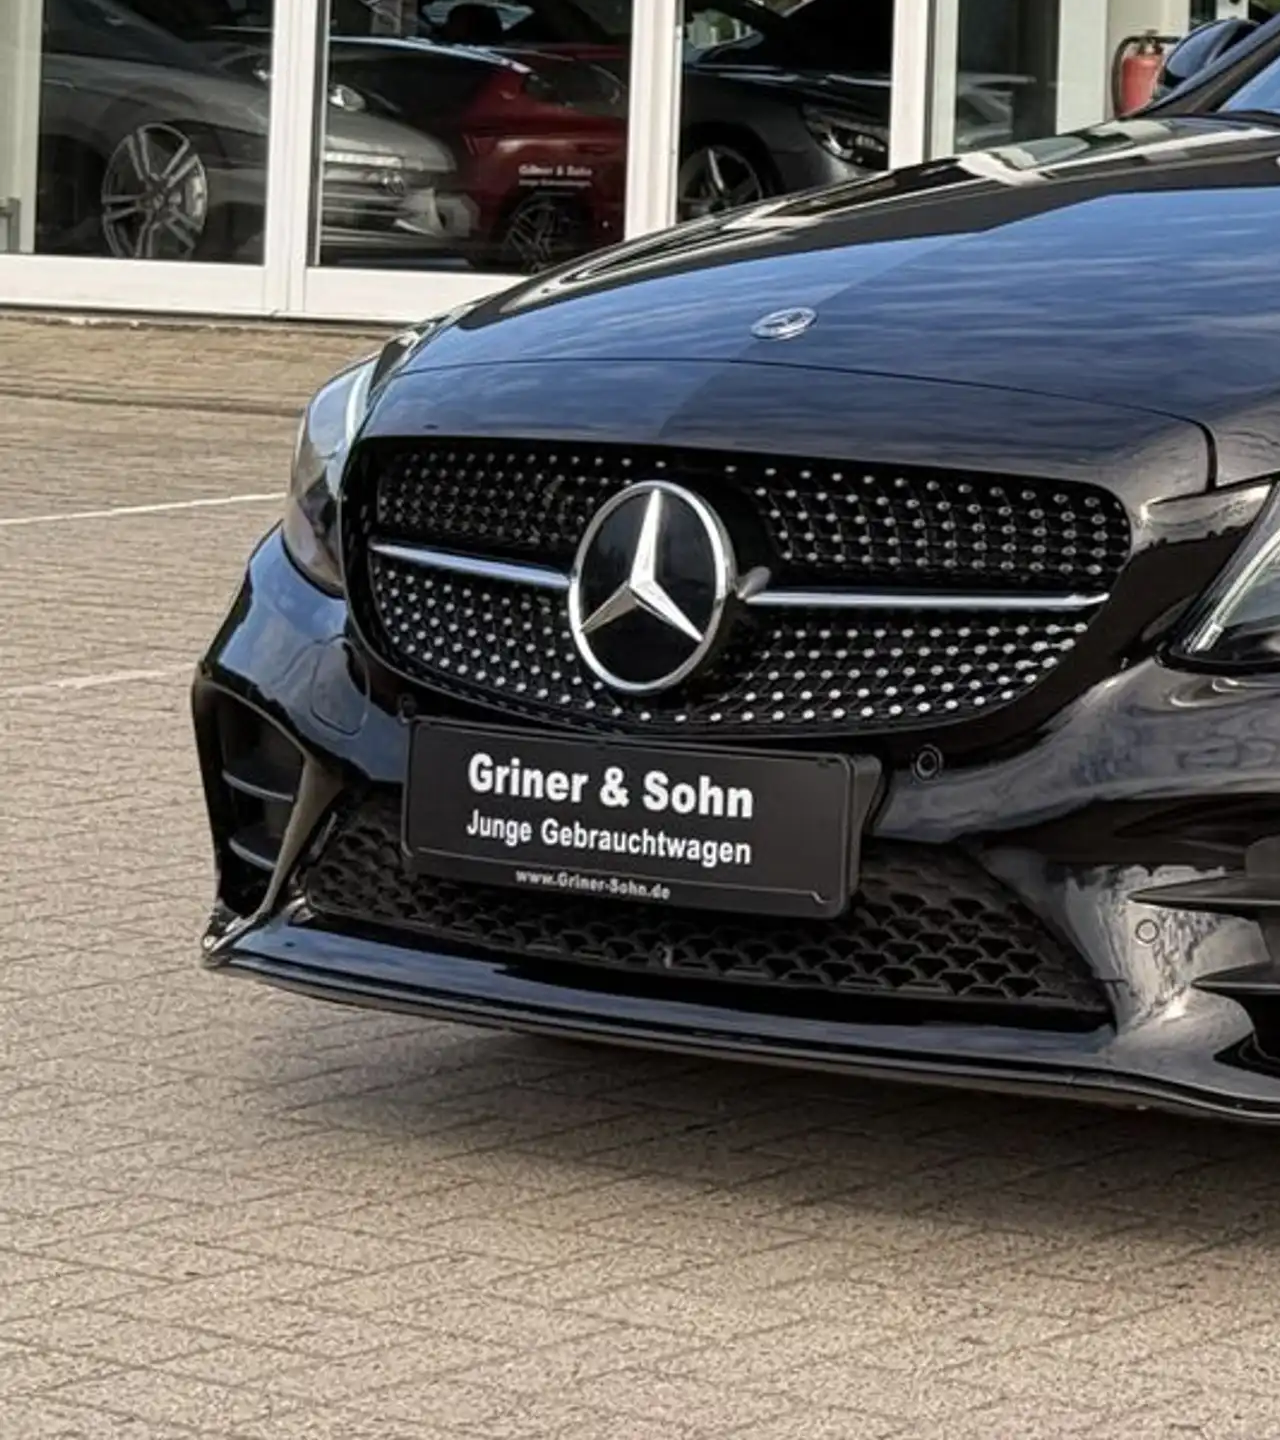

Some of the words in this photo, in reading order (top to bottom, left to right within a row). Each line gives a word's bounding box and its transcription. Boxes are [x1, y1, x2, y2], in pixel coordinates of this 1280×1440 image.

[468, 752, 589, 804] Griner
[599, 766, 631, 808] &
[642, 770, 754, 818] Sohn
[466, 809, 532, 847] Junge
[541, 816, 751, 868] Gebrauchtwagen
[514, 868, 671, 901] www.Griner-Sohn.de
